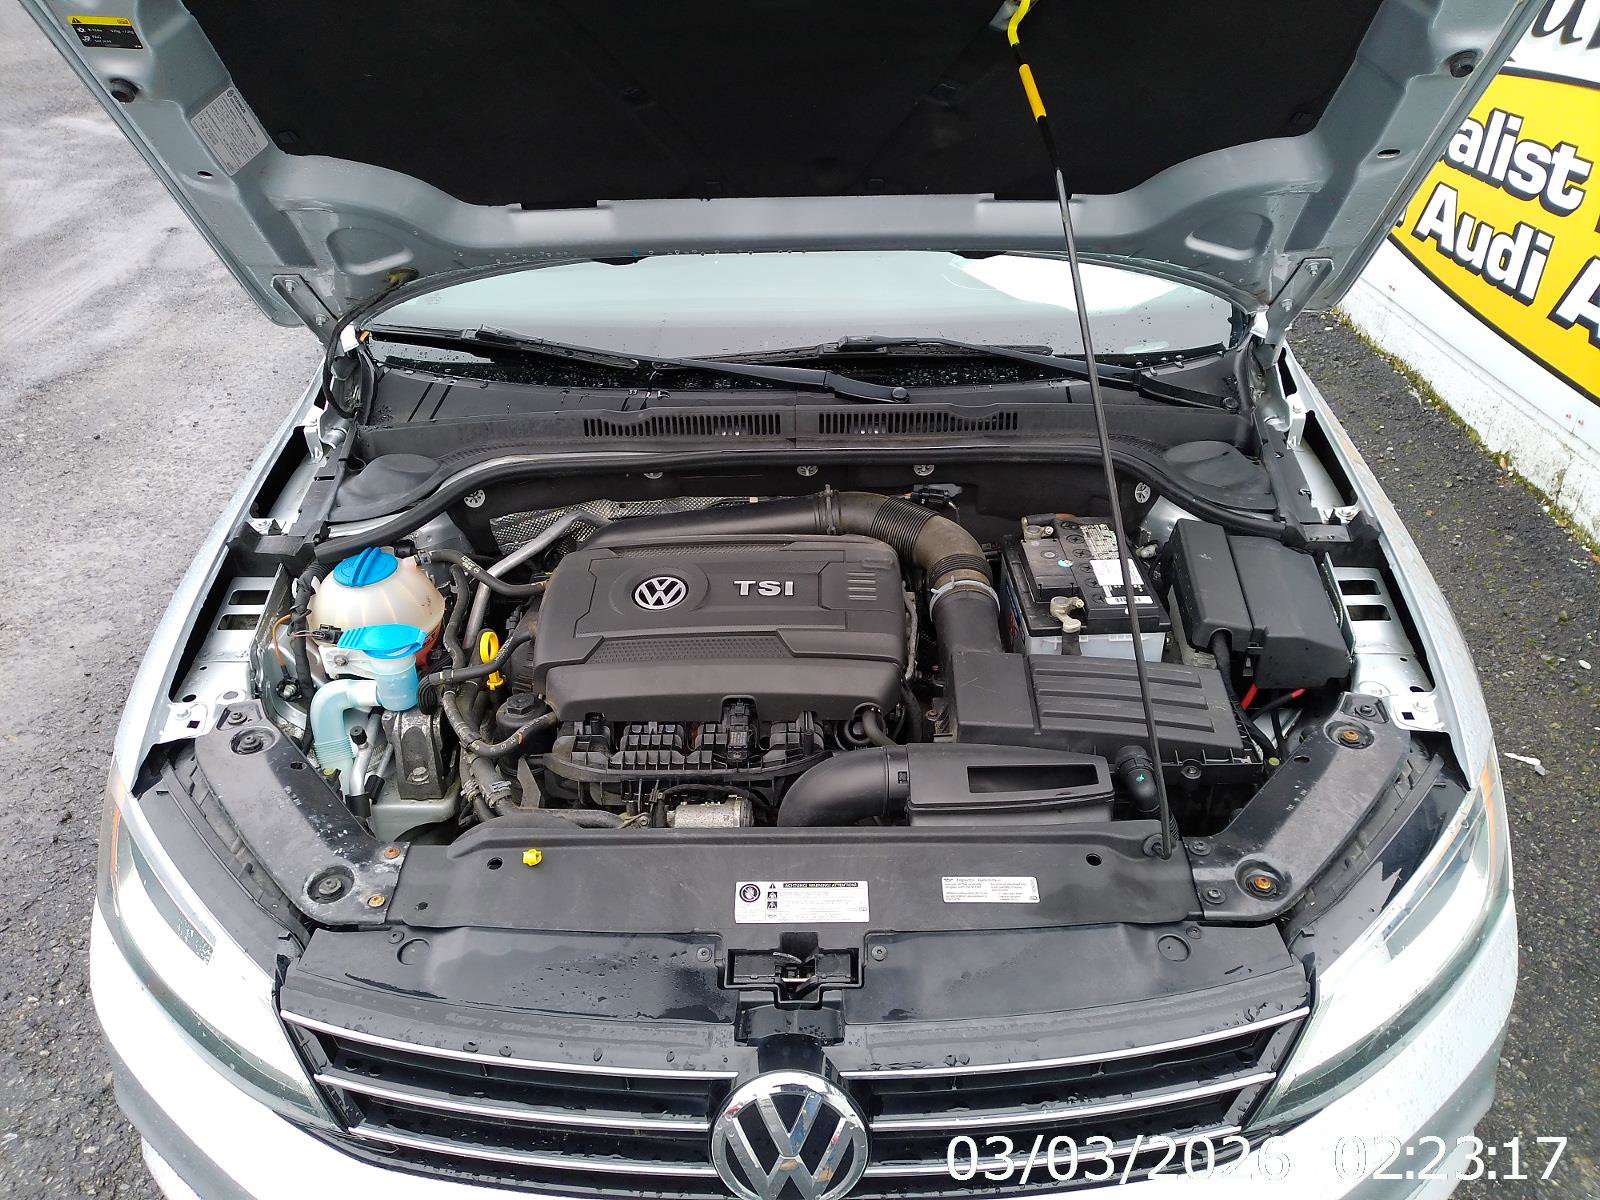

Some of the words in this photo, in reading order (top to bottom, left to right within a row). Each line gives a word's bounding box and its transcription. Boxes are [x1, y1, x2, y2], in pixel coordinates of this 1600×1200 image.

[1440, 107, 1594, 217] alist
[1411, 181, 1555, 306] Audi
[733, 579, 795, 597] TSI
